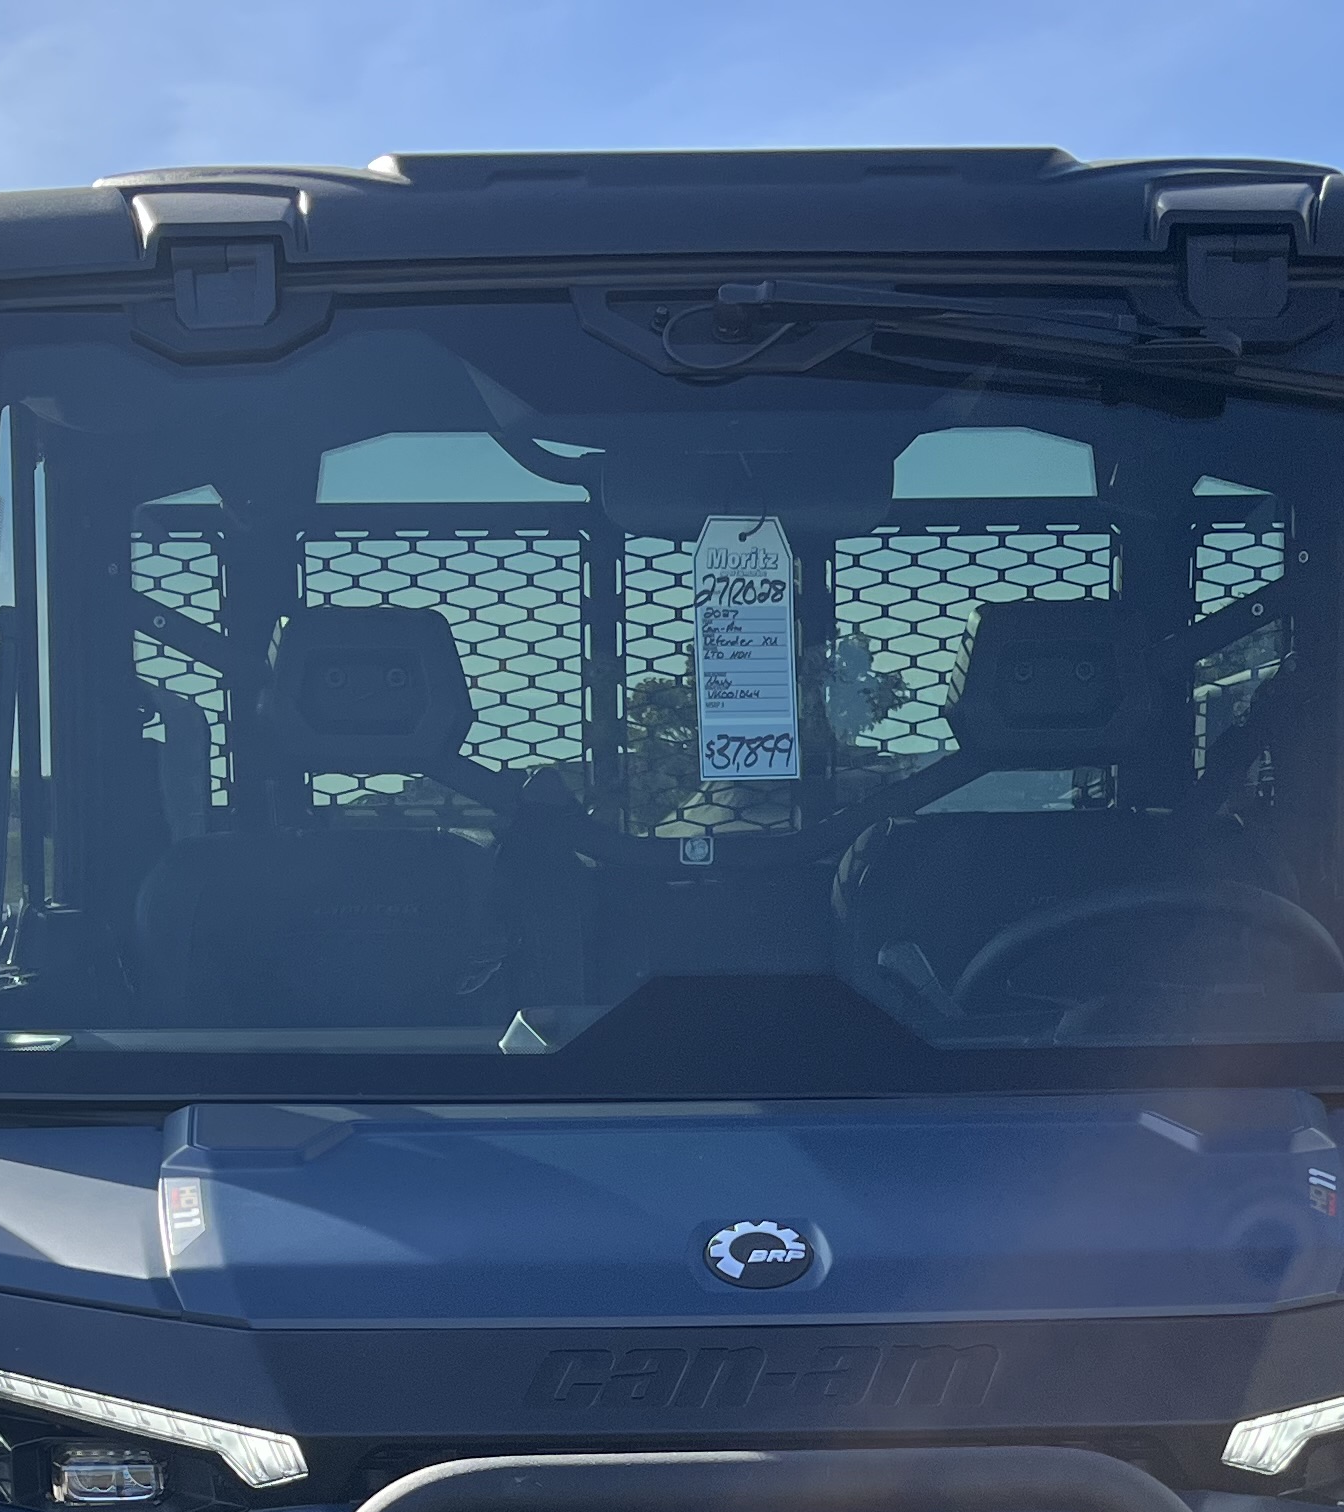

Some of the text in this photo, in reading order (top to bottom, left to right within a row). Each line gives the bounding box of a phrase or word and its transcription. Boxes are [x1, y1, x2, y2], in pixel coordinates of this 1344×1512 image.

[707, 547, 779, 570] Moritz
[705, 733, 794, 773] $37,899
[747, 1249, 806, 1264] BRP
